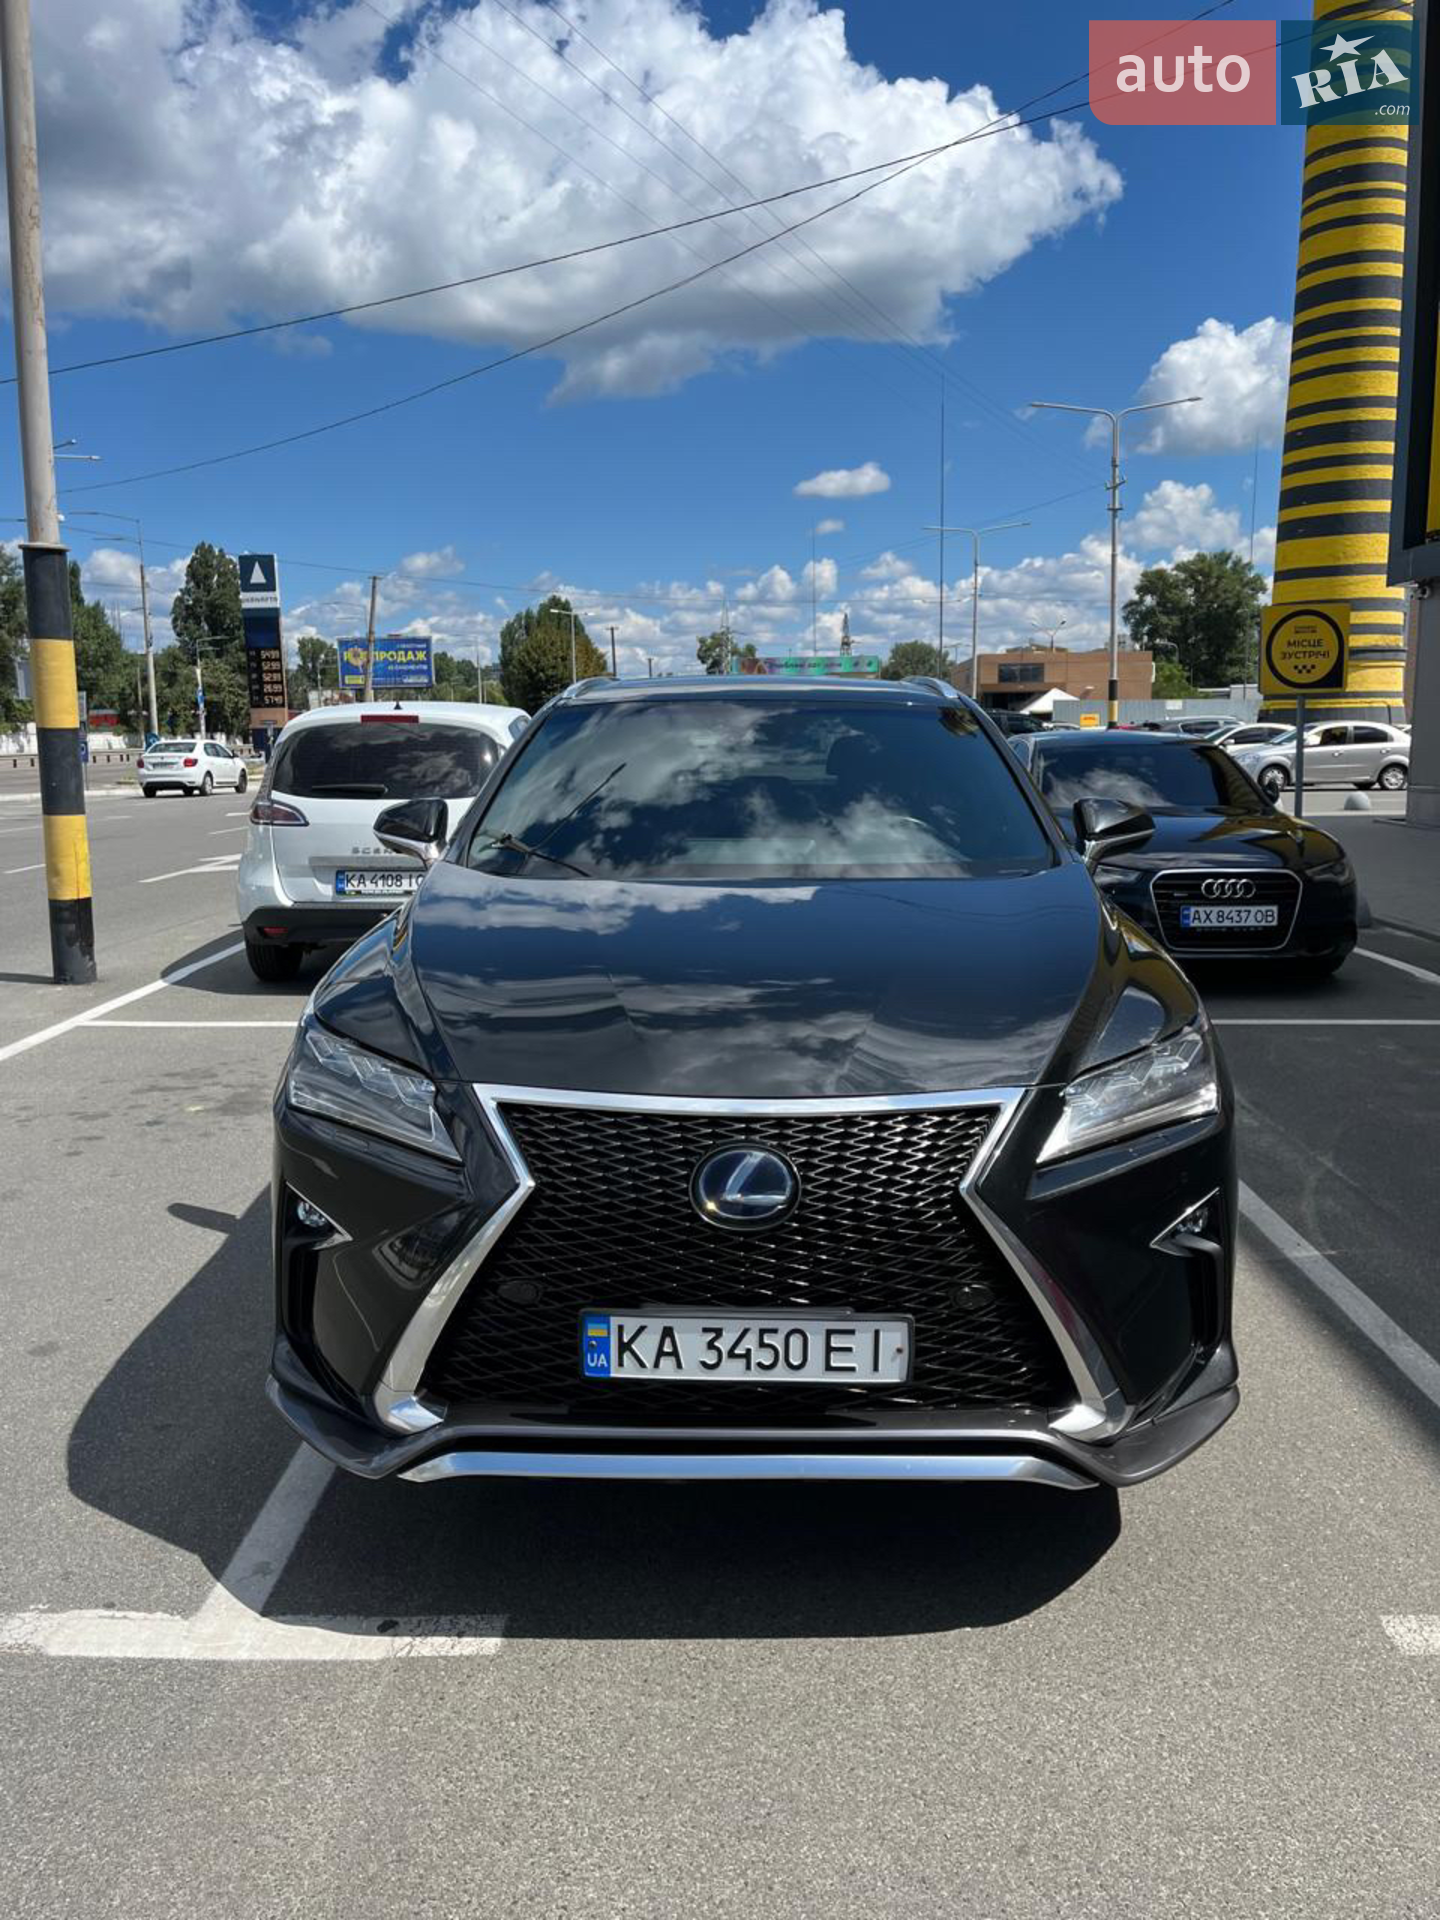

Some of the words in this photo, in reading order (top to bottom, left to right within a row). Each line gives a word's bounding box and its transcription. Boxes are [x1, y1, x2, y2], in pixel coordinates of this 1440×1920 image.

[1287, 638, 1324, 648] МІСЦЕ
[1281, 650, 1330, 660] ЗУСТРІЧІ
[346, 874, 366, 888] KA
[370, 874, 403, 888] 4108
[1191, 909, 1213, 924] AX
[1216, 909, 1251, 924] 8437
[1254, 909, 1276, 924] OB
[617, 1324, 684, 1370] KA
[699, 1326, 809, 1372] 3450
[825, 1328, 881, 1373] EI
[587, 1353, 608, 1368] UA
